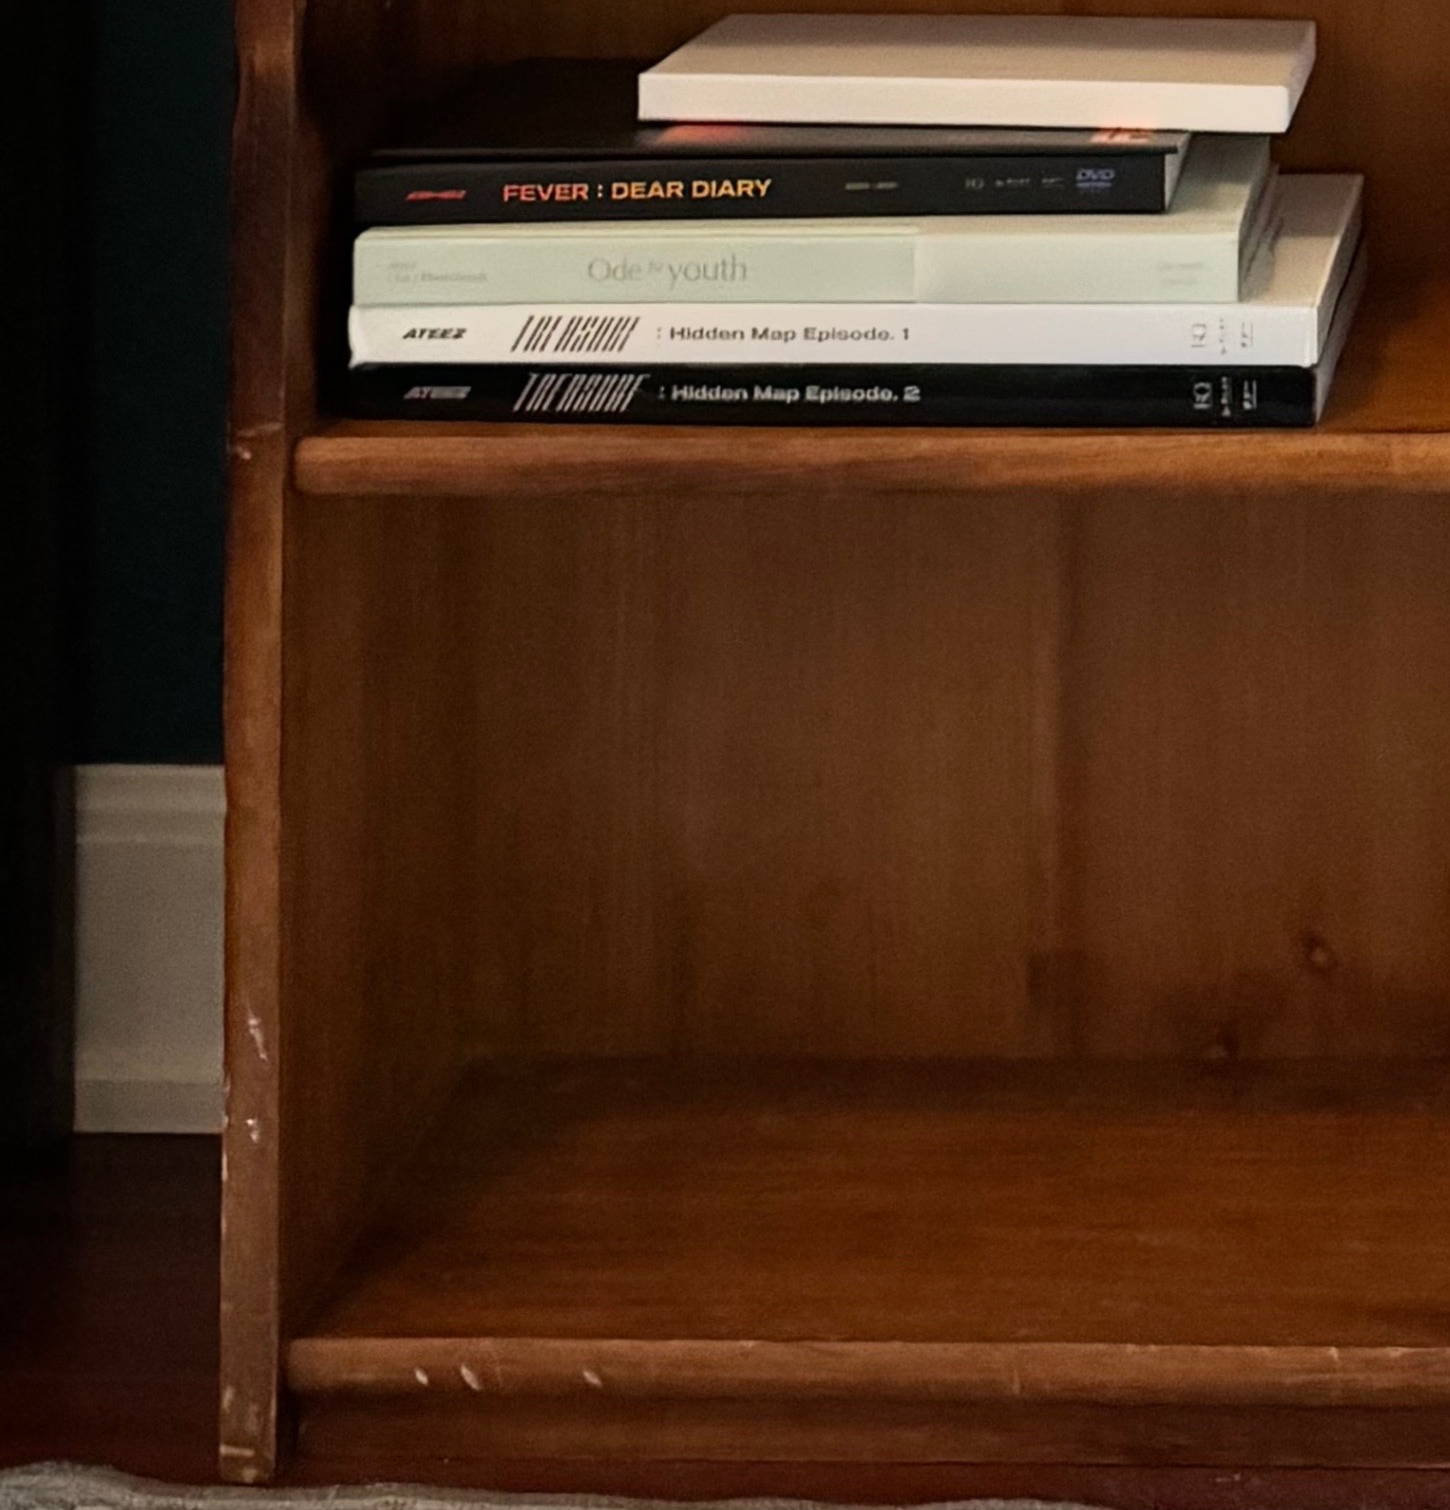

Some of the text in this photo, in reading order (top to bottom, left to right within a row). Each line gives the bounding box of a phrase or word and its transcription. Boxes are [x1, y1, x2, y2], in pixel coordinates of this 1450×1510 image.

[502, 178, 772, 202] FEVER DEAR DIARY
[669, 325, 910, 344] Hidden Map Episode. 1
